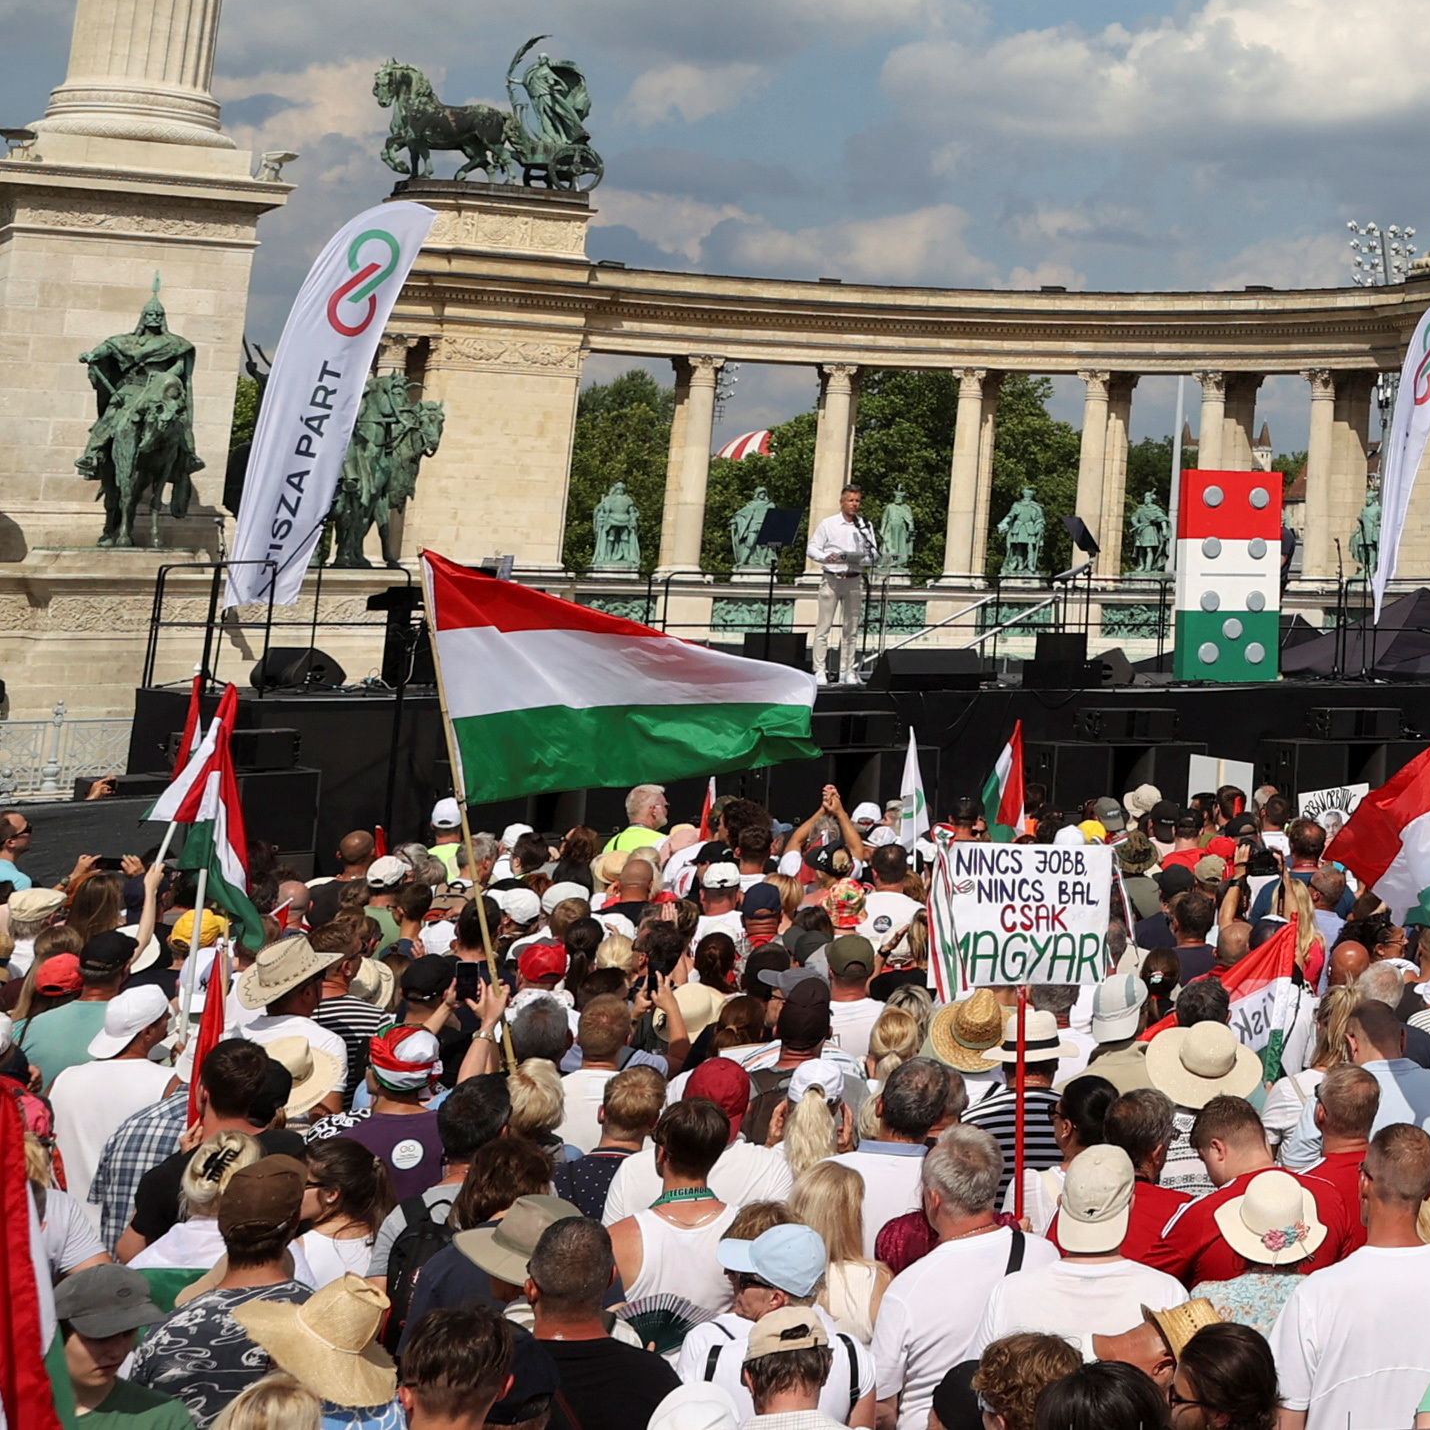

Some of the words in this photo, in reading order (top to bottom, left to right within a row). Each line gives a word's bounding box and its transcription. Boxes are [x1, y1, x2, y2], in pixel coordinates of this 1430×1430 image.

[294, 360, 341, 458] PÁRT
[955, 848, 1023, 877] NINCS
[977, 878, 1045, 904] NINCS
[1058, 880, 1099, 907] BAL,
[1000, 904, 1067, 932] CSAK
